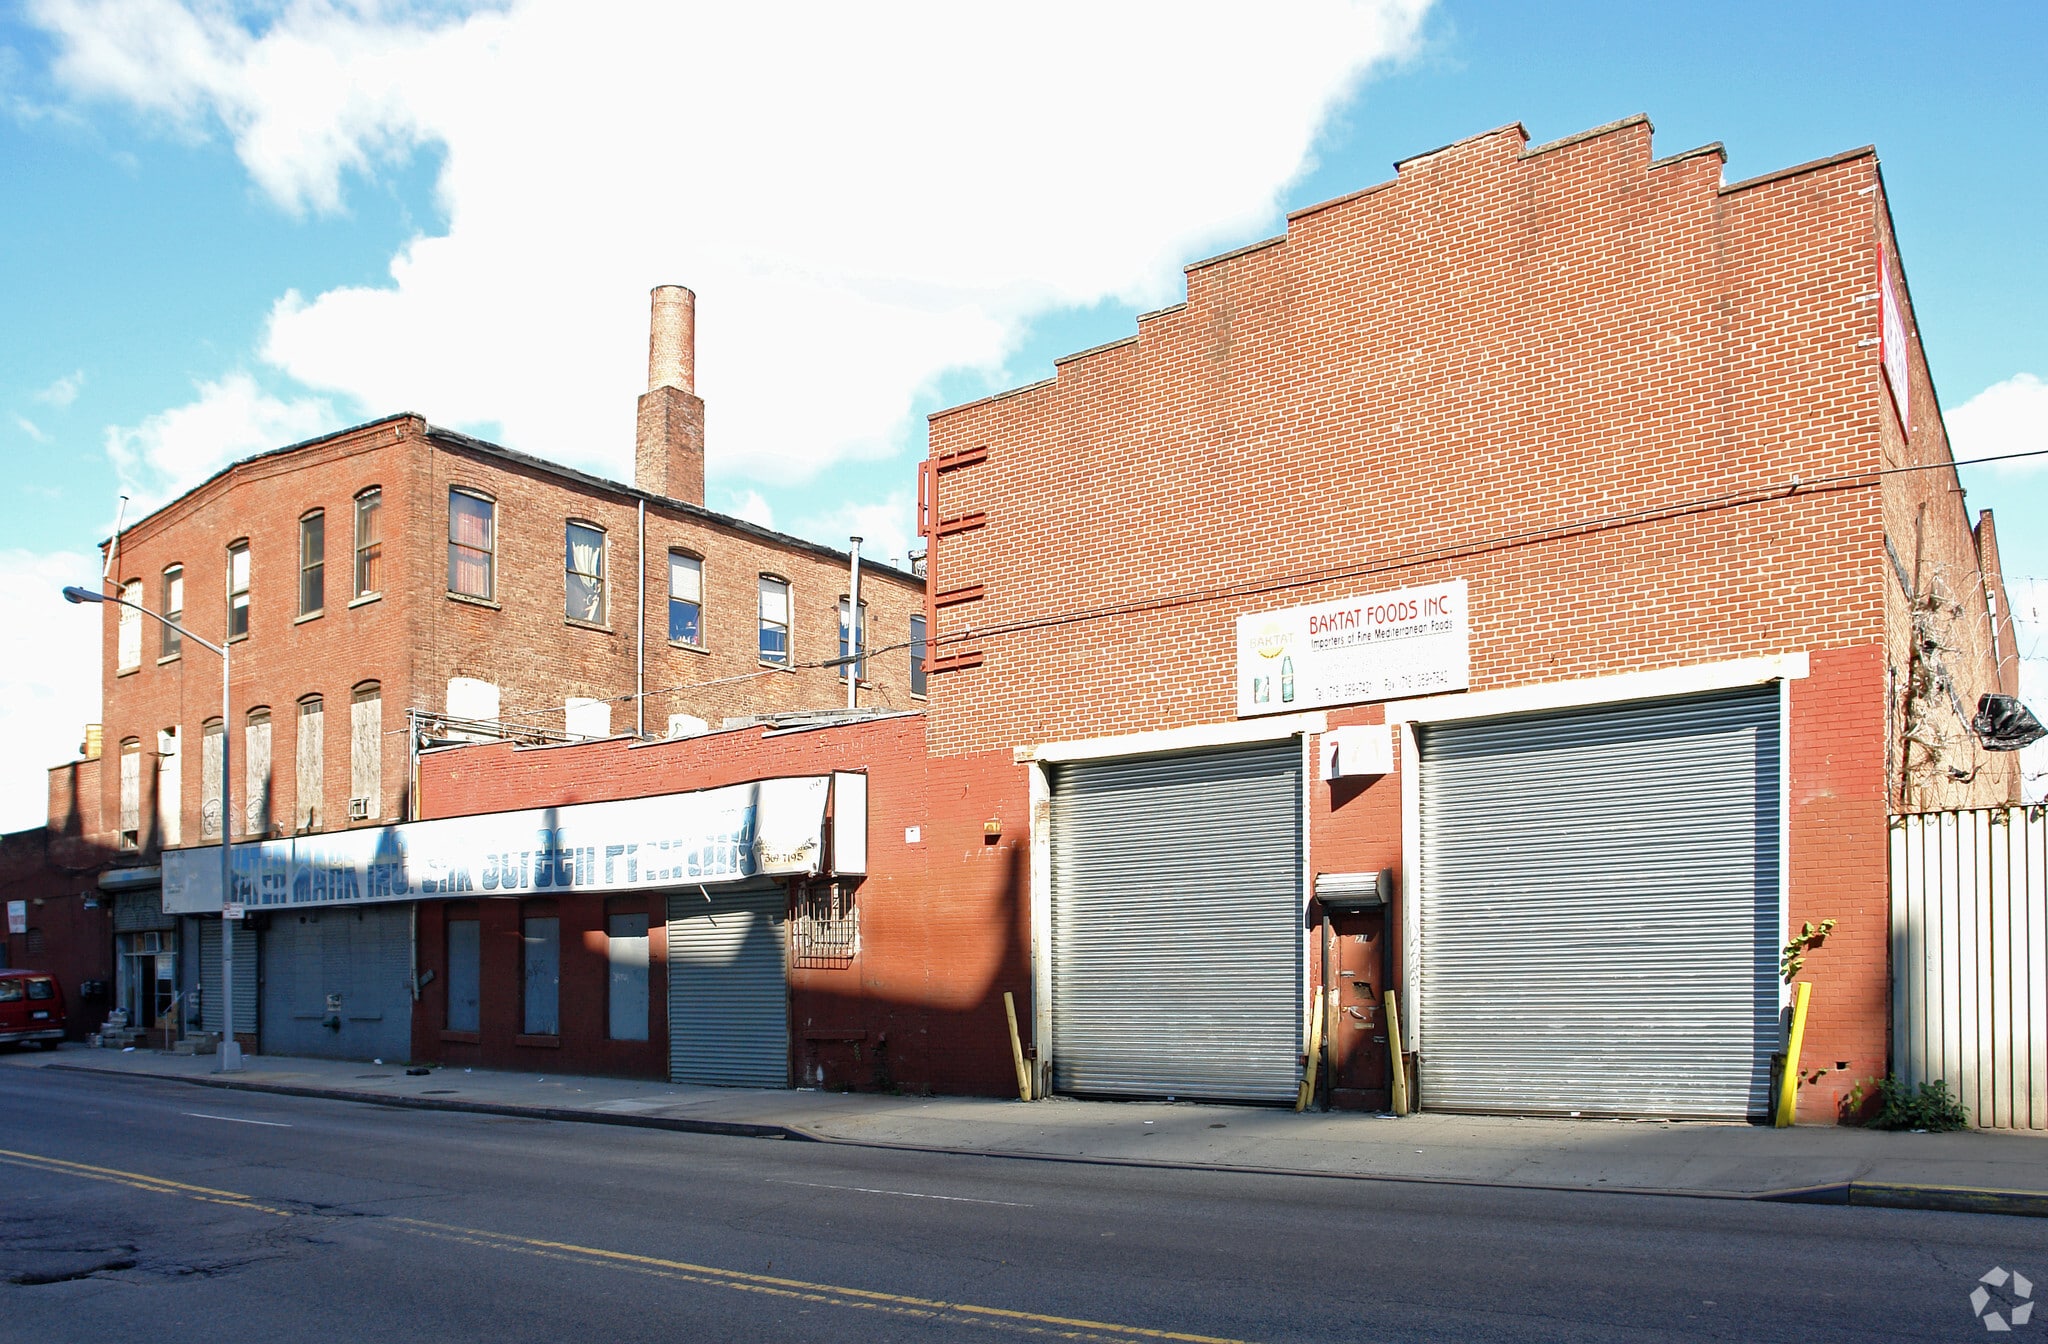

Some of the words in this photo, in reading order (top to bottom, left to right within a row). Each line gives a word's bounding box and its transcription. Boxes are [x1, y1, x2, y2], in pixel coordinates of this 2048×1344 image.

[1310, 608, 1361, 635] BAKTAT
[1367, 599, 1418, 626] FOODS
[1250, 632, 1294, 649] BAKTAT
[1311, 636, 1344, 650] Importers
[1347, 633, 1355, 645] of
[1357, 630, 1372, 642] Fine
[1374, 623, 1428, 640] Mediterranean
[1431, 619, 1453, 631] Foods
